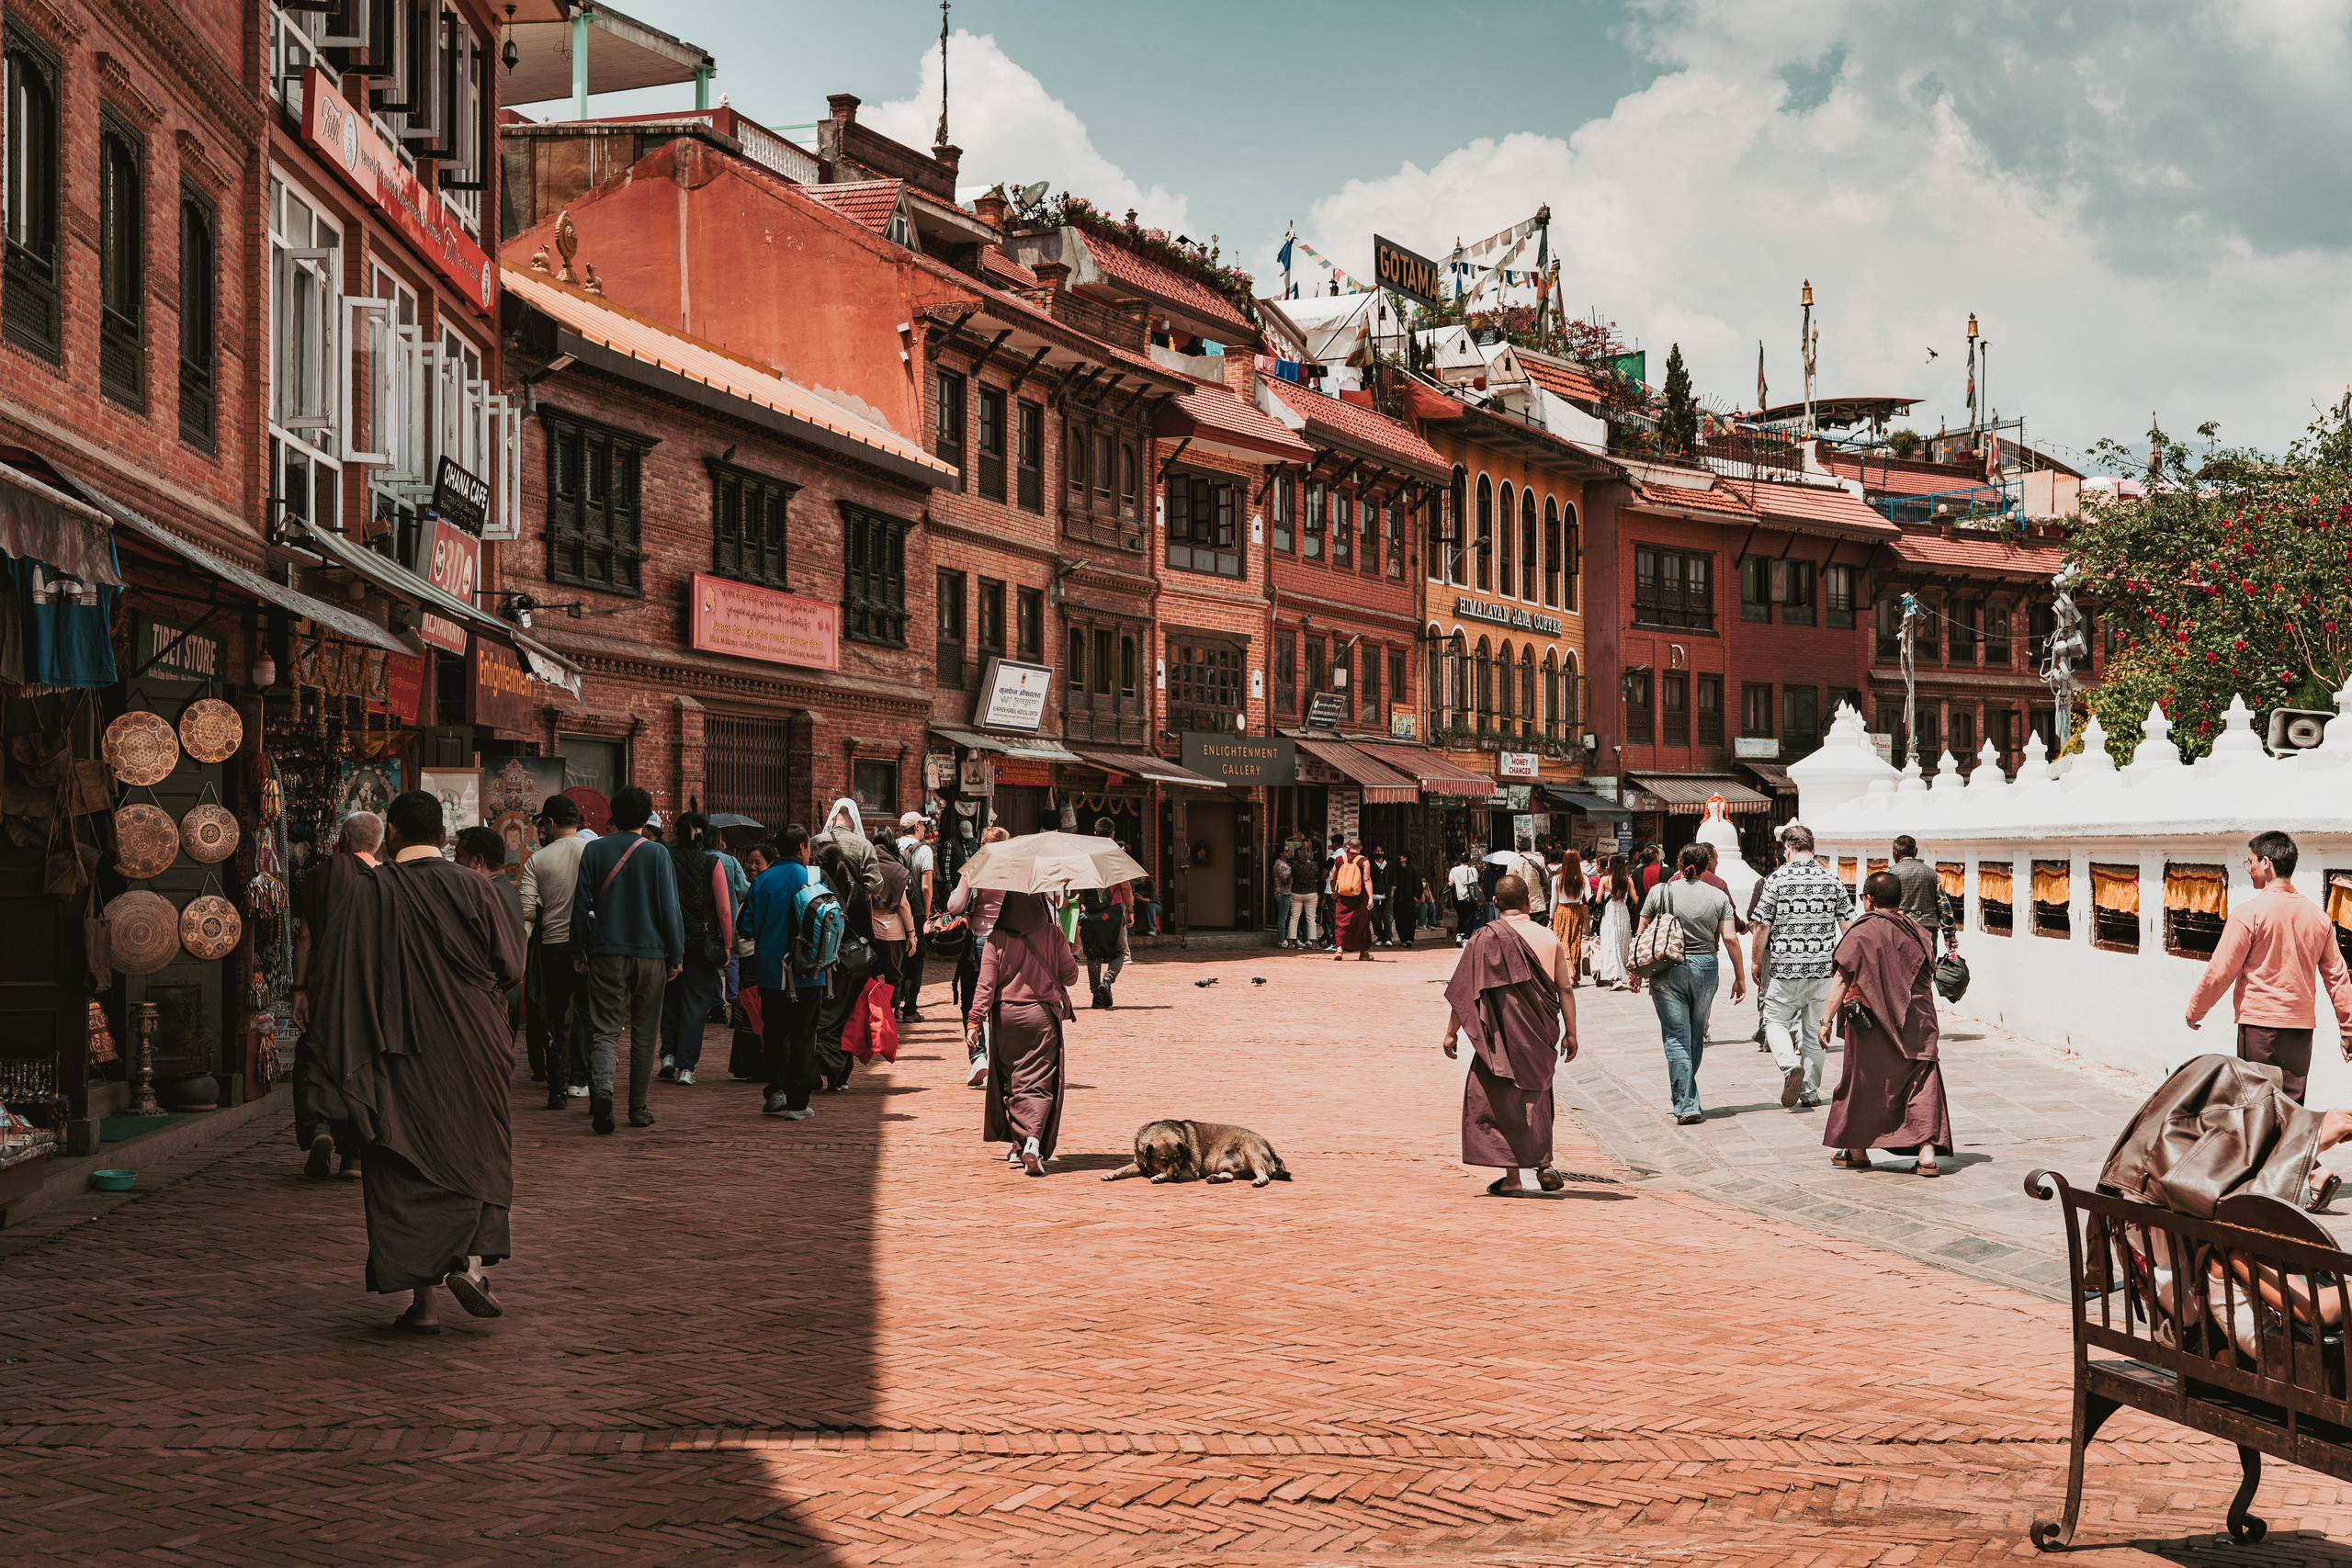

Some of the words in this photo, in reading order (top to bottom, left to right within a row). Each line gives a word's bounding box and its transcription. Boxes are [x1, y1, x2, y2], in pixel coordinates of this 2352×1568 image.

[383, 174, 397, 197] most
[398, 184, 412, 213] loved
[412, 204, 422, 223] tea
[426, 221, 441, 245] coffee
[1380, 244, 1439, 302] GOTAMA
[444, 462, 469, 499] OHANA
[469, 480, 488, 510] CAFE
[1458, 596, 1510, 623] HIMALAYAN
[1512, 608, 1532, 628] JAVA
[1533, 613, 1562, 634] COFFEE
[153, 623, 183, 667] TIBET
[184, 634, 217, 676] STORE
[1669, 644, 1685, 669] D
[1203, 744, 1278, 759] ENLIGHTENMENT
[1222, 763, 1261, 776] GALLERY
[1509, 766, 1532, 774] CHANGER
[1496, 787, 1508, 798] TAMA
[272, 1029, 300, 1037] EPTED
